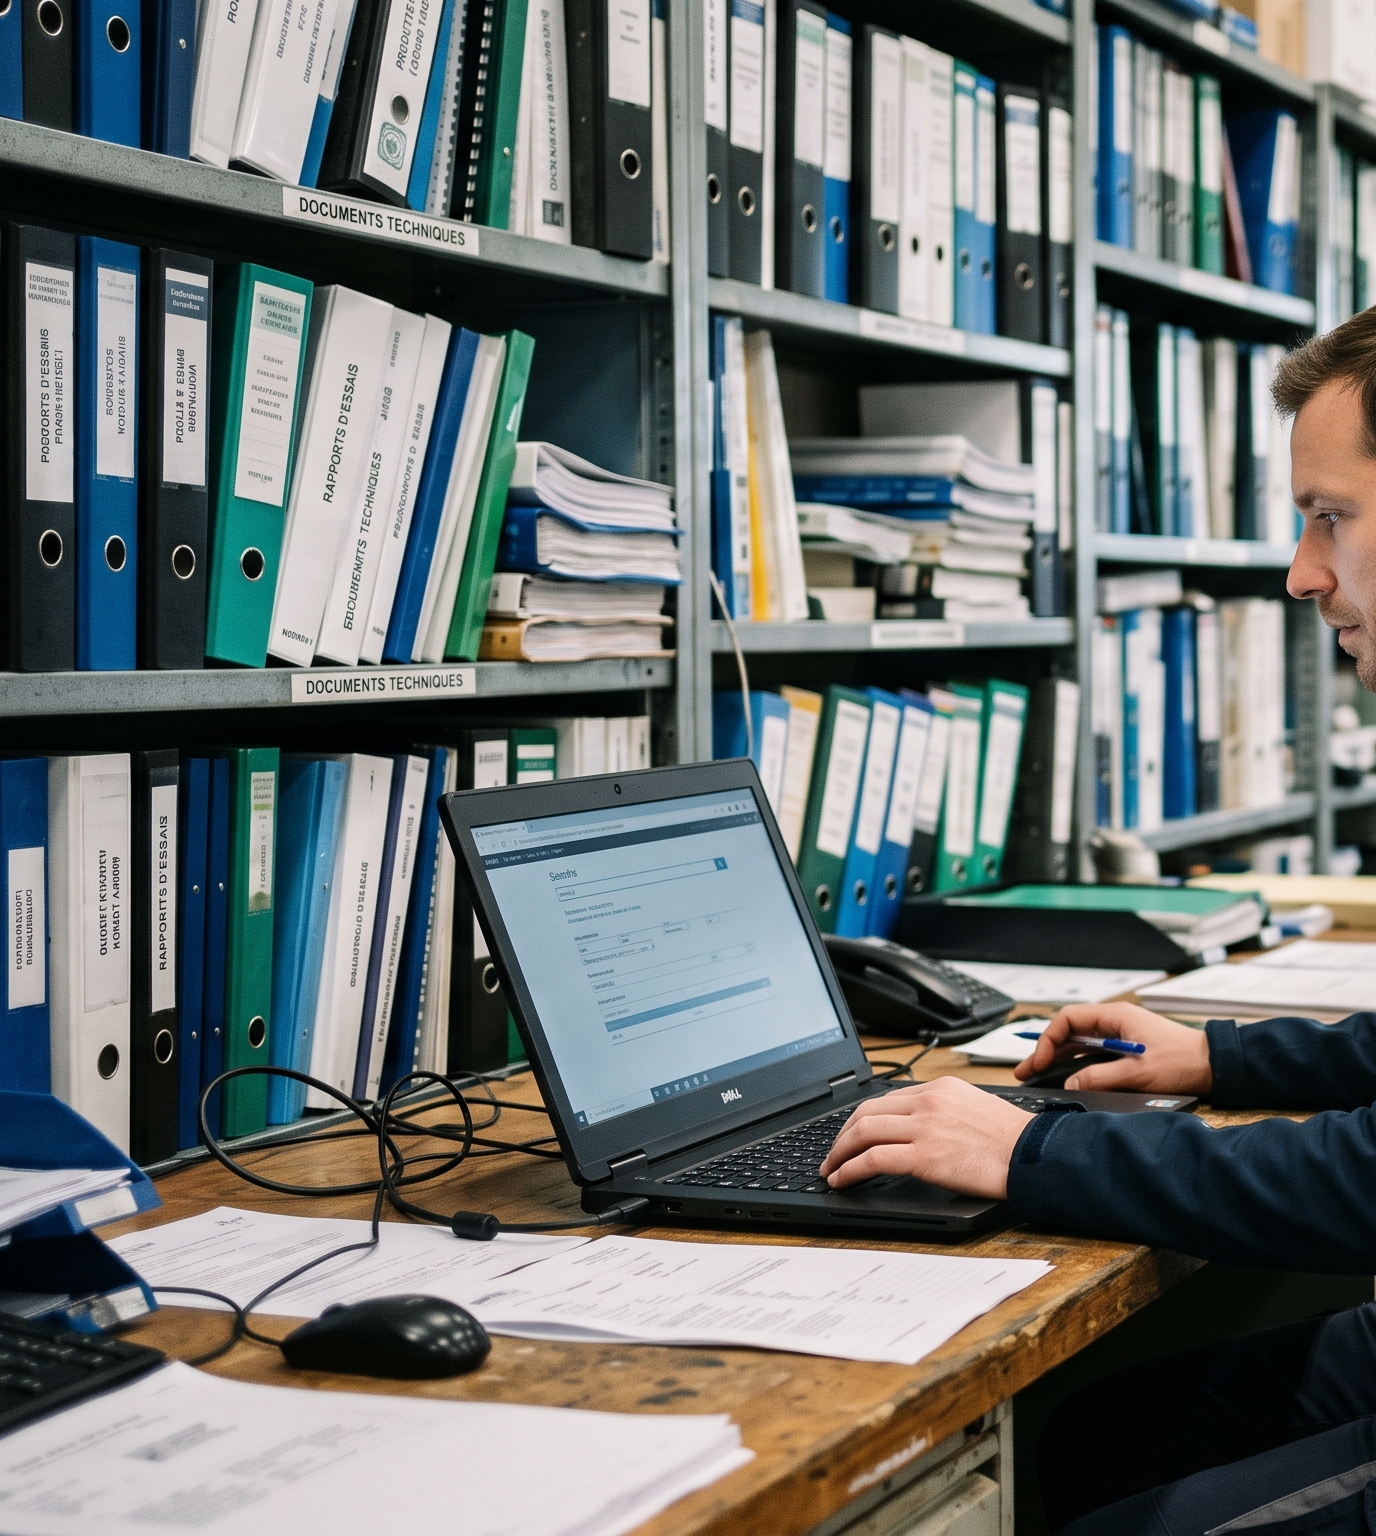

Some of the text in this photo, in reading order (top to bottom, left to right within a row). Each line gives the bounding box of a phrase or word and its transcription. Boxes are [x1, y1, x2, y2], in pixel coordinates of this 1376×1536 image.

[299, 196, 466, 246] DOCUMENTS TECHNIQUES
[323, 363, 359, 503] RAPPORTS D'ESSAIS
[306, 673, 463, 695] DOCUMENTS TECHNIQUES
[158, 815, 168, 884] D'ESSAIS
